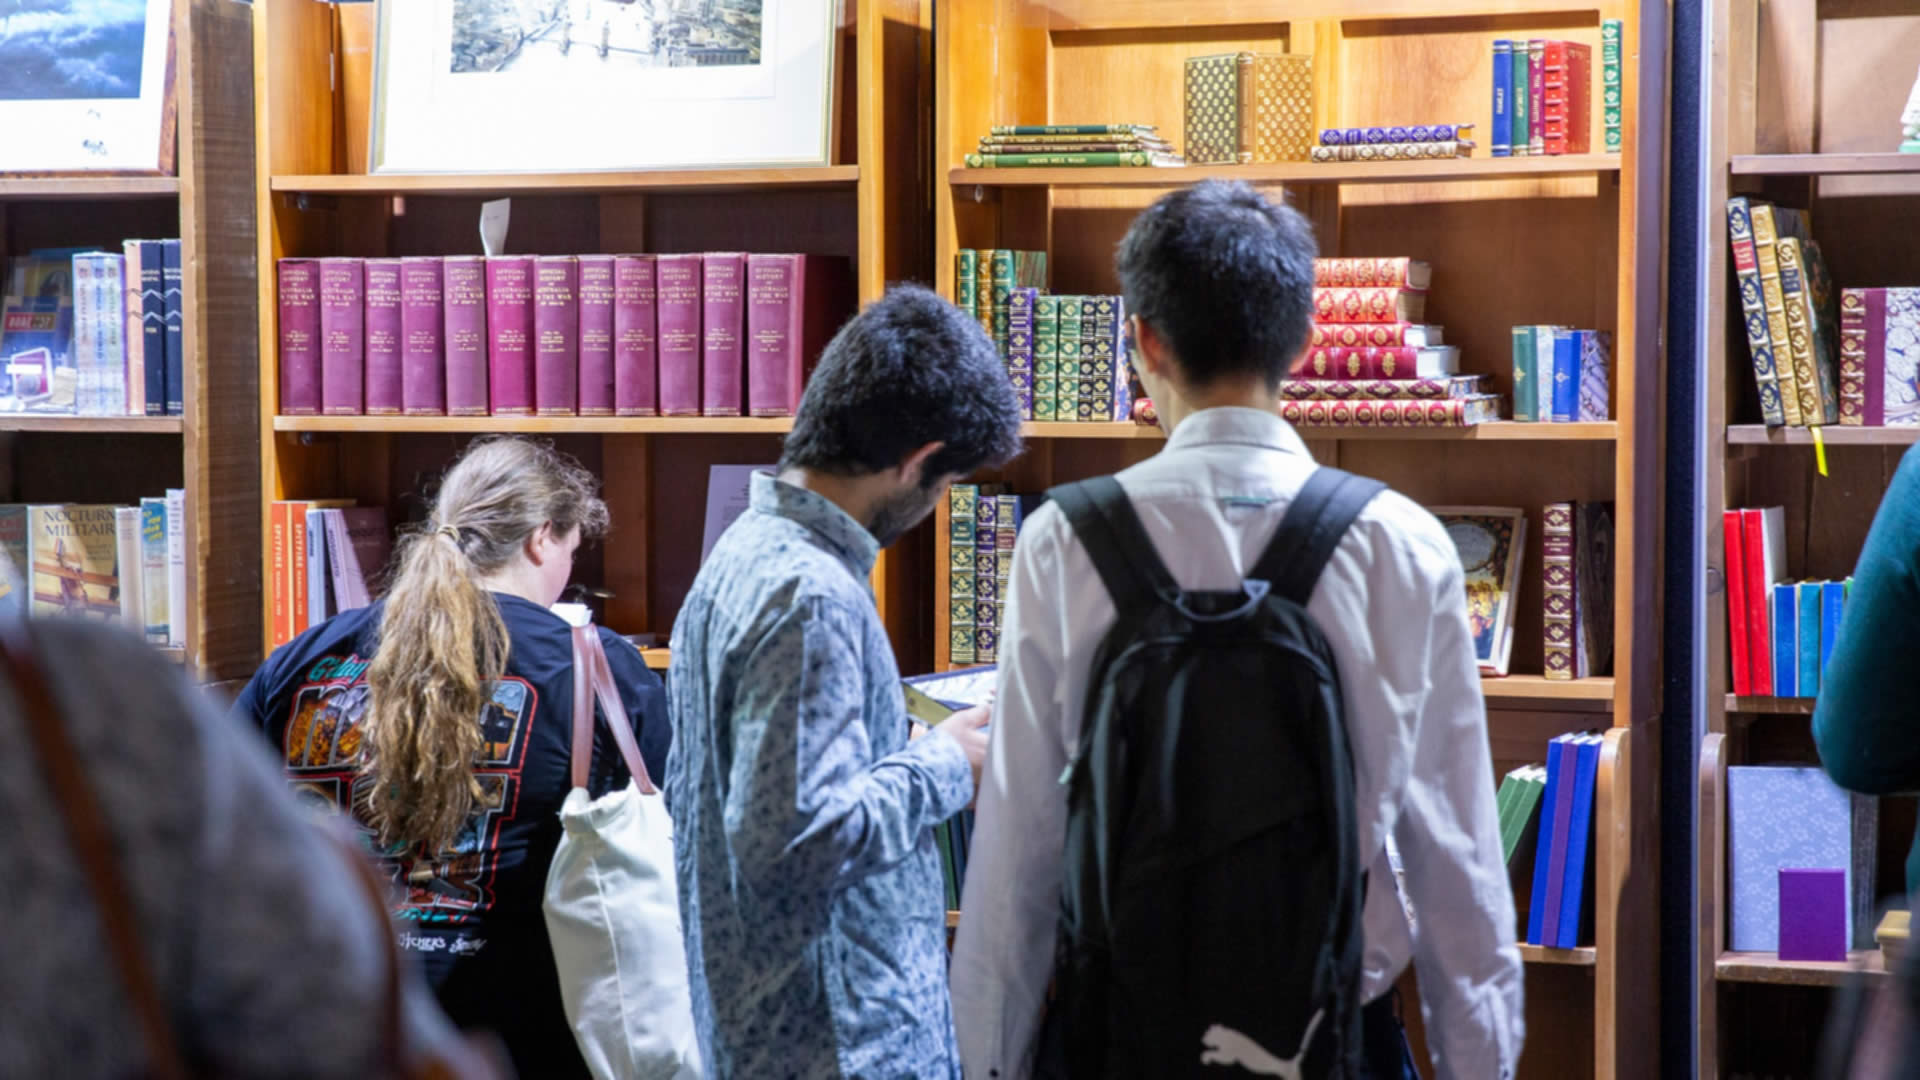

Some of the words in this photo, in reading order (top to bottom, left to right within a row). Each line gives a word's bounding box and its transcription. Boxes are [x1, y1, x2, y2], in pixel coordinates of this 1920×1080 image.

[274, 523, 283, 568] SPITFIRE
[296, 523, 304, 568] SPITFIRE
[308, 655, 369, 685] G'day
